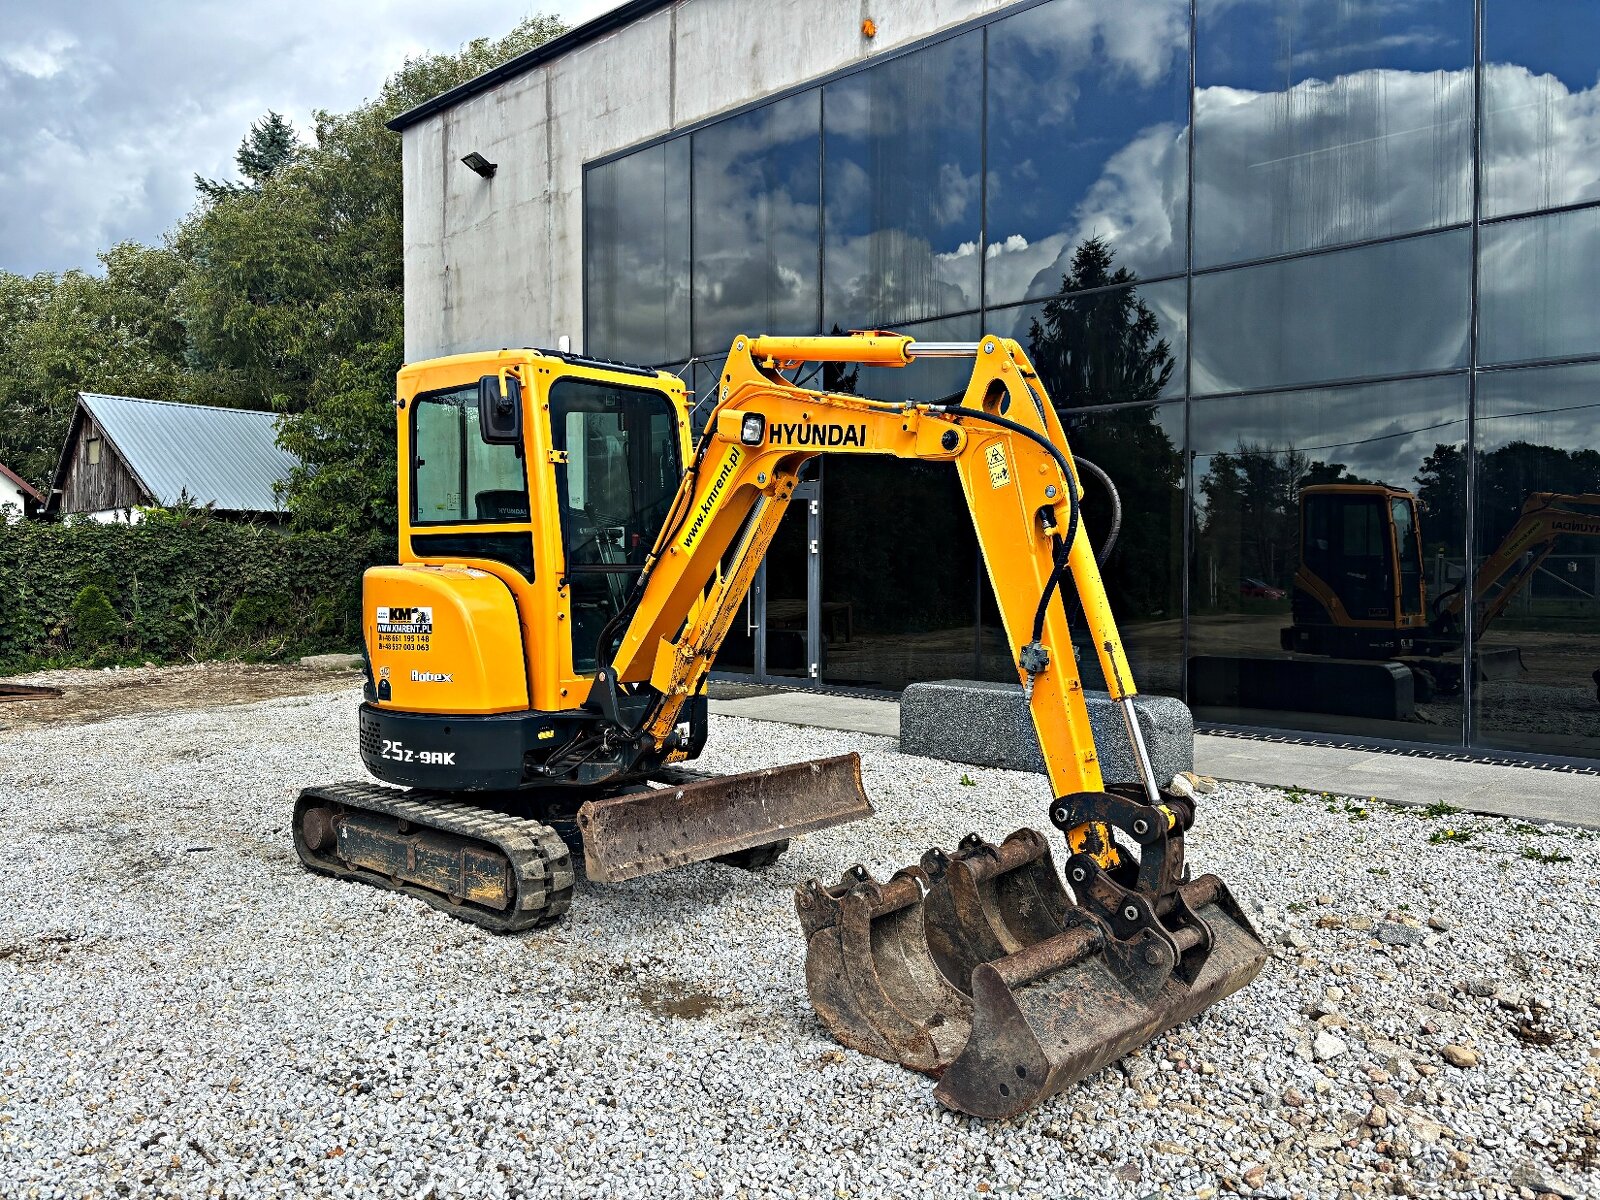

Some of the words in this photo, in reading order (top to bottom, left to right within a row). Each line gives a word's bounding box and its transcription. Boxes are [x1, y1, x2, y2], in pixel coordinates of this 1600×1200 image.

[768, 423, 867, 447] HYUNDAI
[682, 446, 742, 548] www.kmrent.pl
[389, 608, 412, 621] KM
[416, 634, 430, 643] 148
[416, 643, 430, 652] 063
